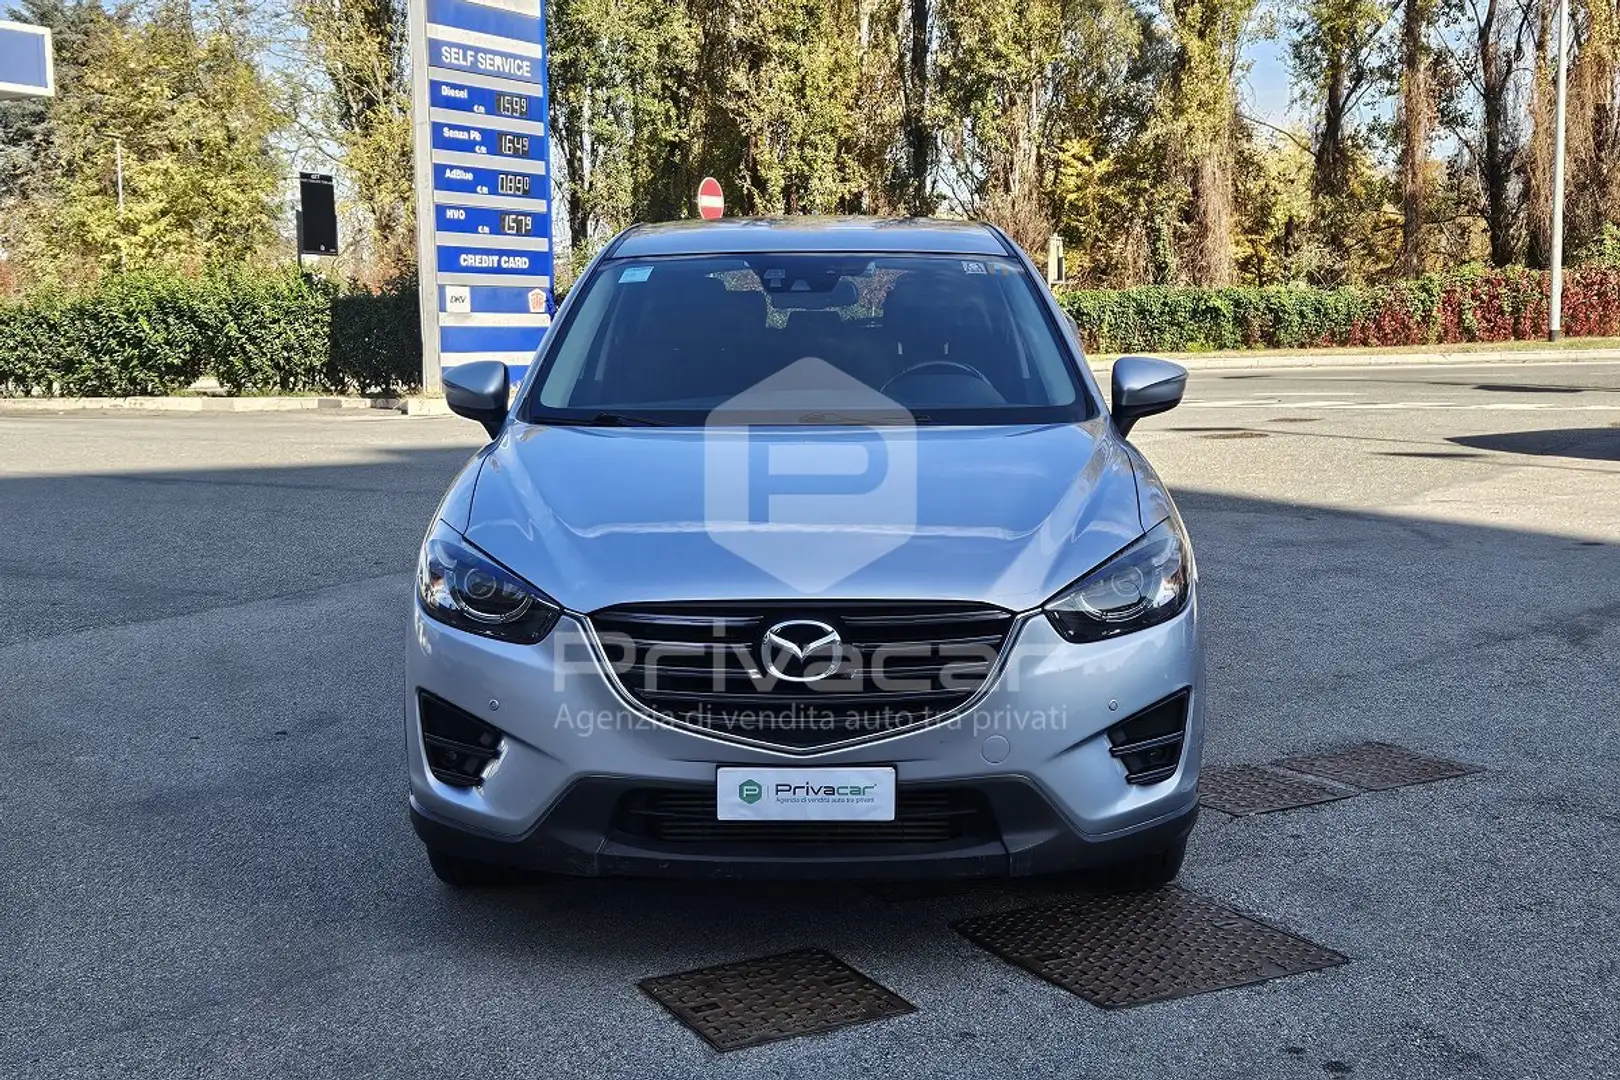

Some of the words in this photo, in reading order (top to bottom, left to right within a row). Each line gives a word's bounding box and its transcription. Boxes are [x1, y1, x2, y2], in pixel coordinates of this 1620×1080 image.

[441, 46, 475, 66] SELF
[477, 52, 532, 77] SERVICE
[441, 86, 468, 98] Diesel
[442, 127, 469, 140] Senza
[469, 129, 482, 141] Pb
[444, 168, 474, 181] AdBlue
[446, 208, 466, 220] HVO
[459, 253, 499, 267] CREDIT
[501, 256, 530, 269] CARD
[449, 295, 467, 304] DKV
[775, 781, 875, 796] Privacar
